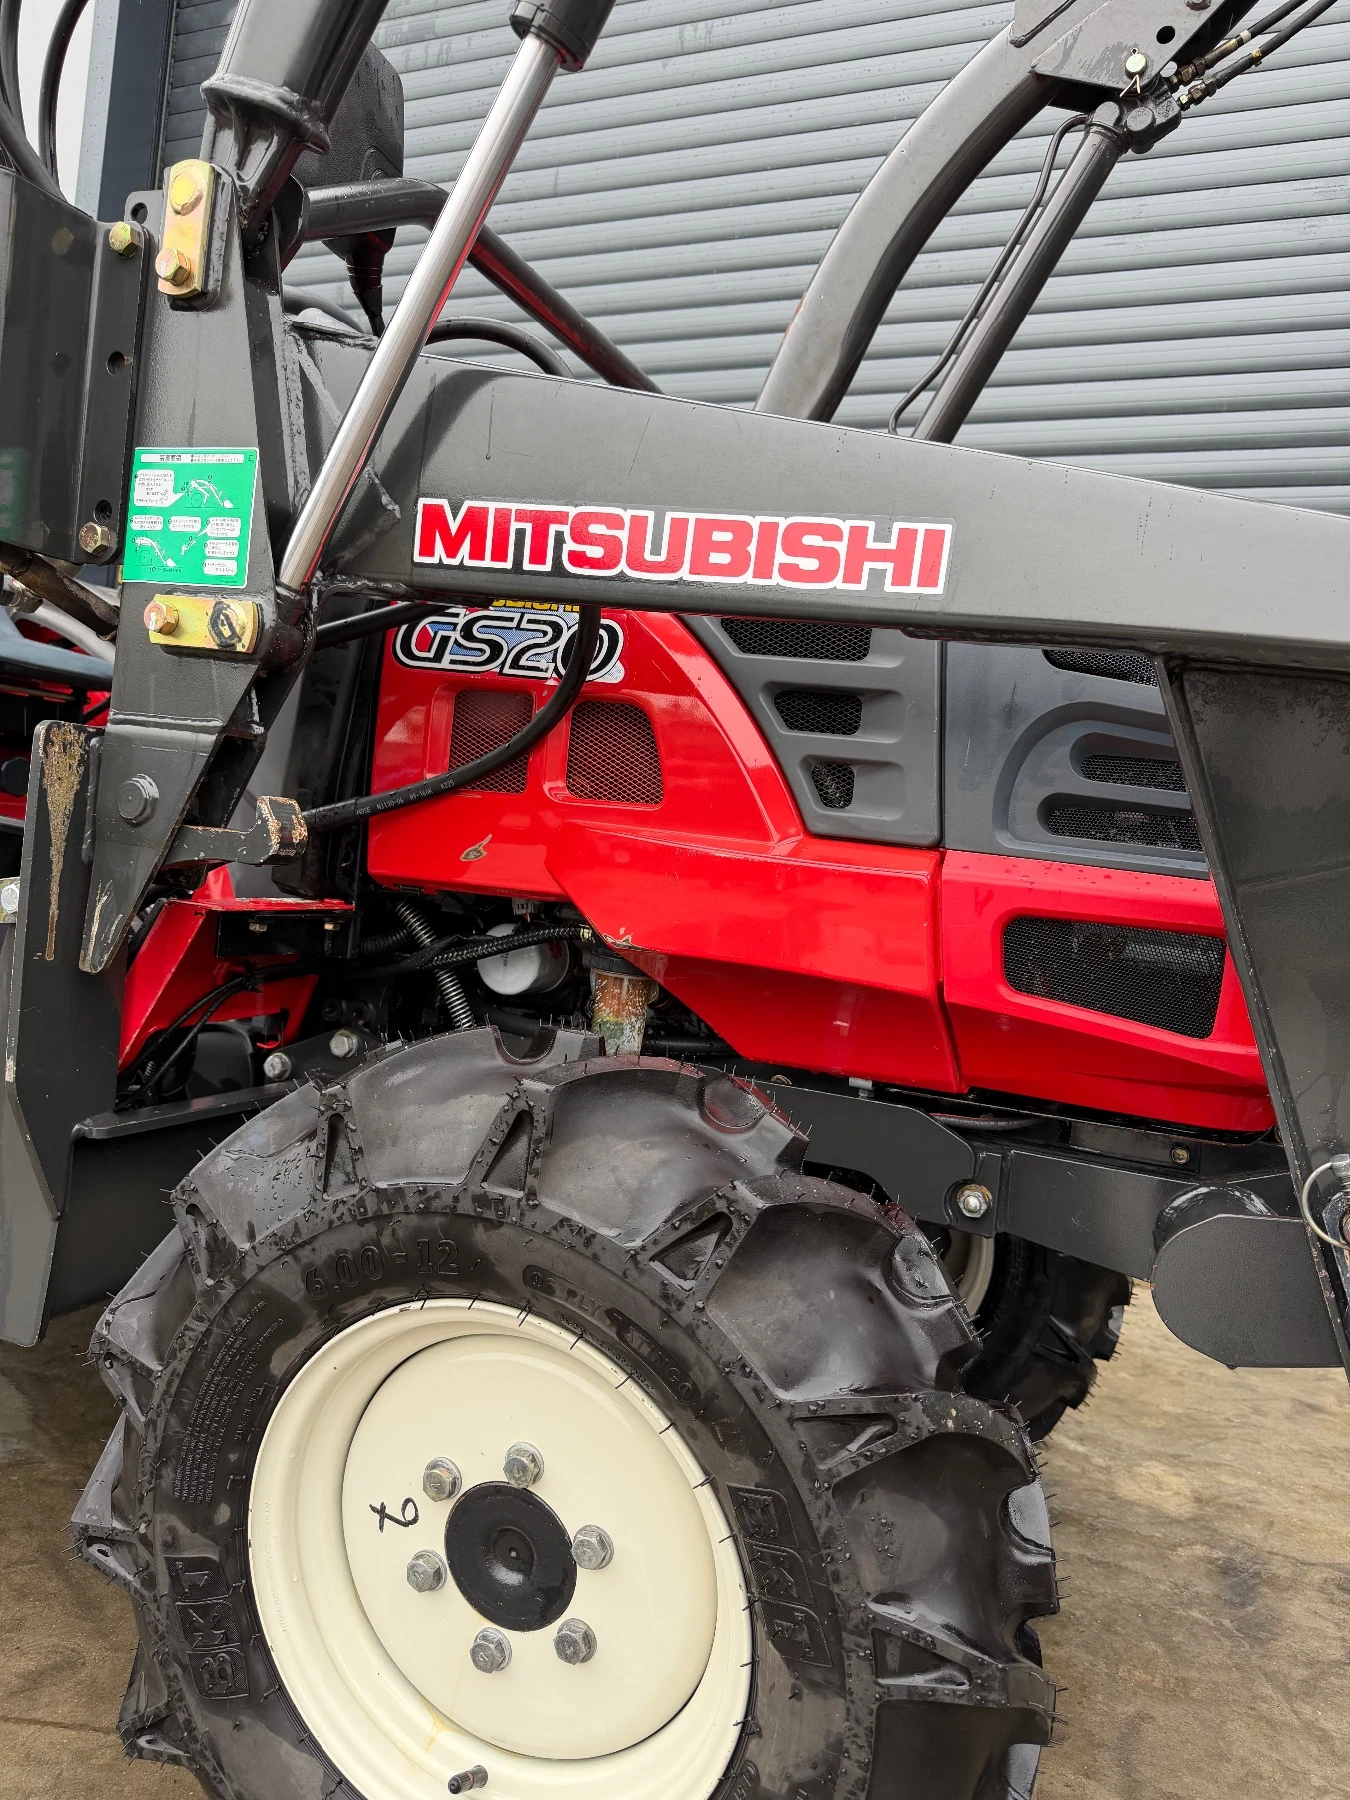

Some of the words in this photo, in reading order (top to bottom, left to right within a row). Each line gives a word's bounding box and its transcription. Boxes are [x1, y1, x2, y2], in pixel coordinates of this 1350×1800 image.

[414, 499, 952, 595] MITSUBISHI
[393, 606, 624, 682] GS20
[305, 1238, 459, 1300] 6.00-12
[565, 1287, 602, 1317] PLY
[737, 1491, 815, 1659] BKT
[172, 1560, 238, 1695] BKT
